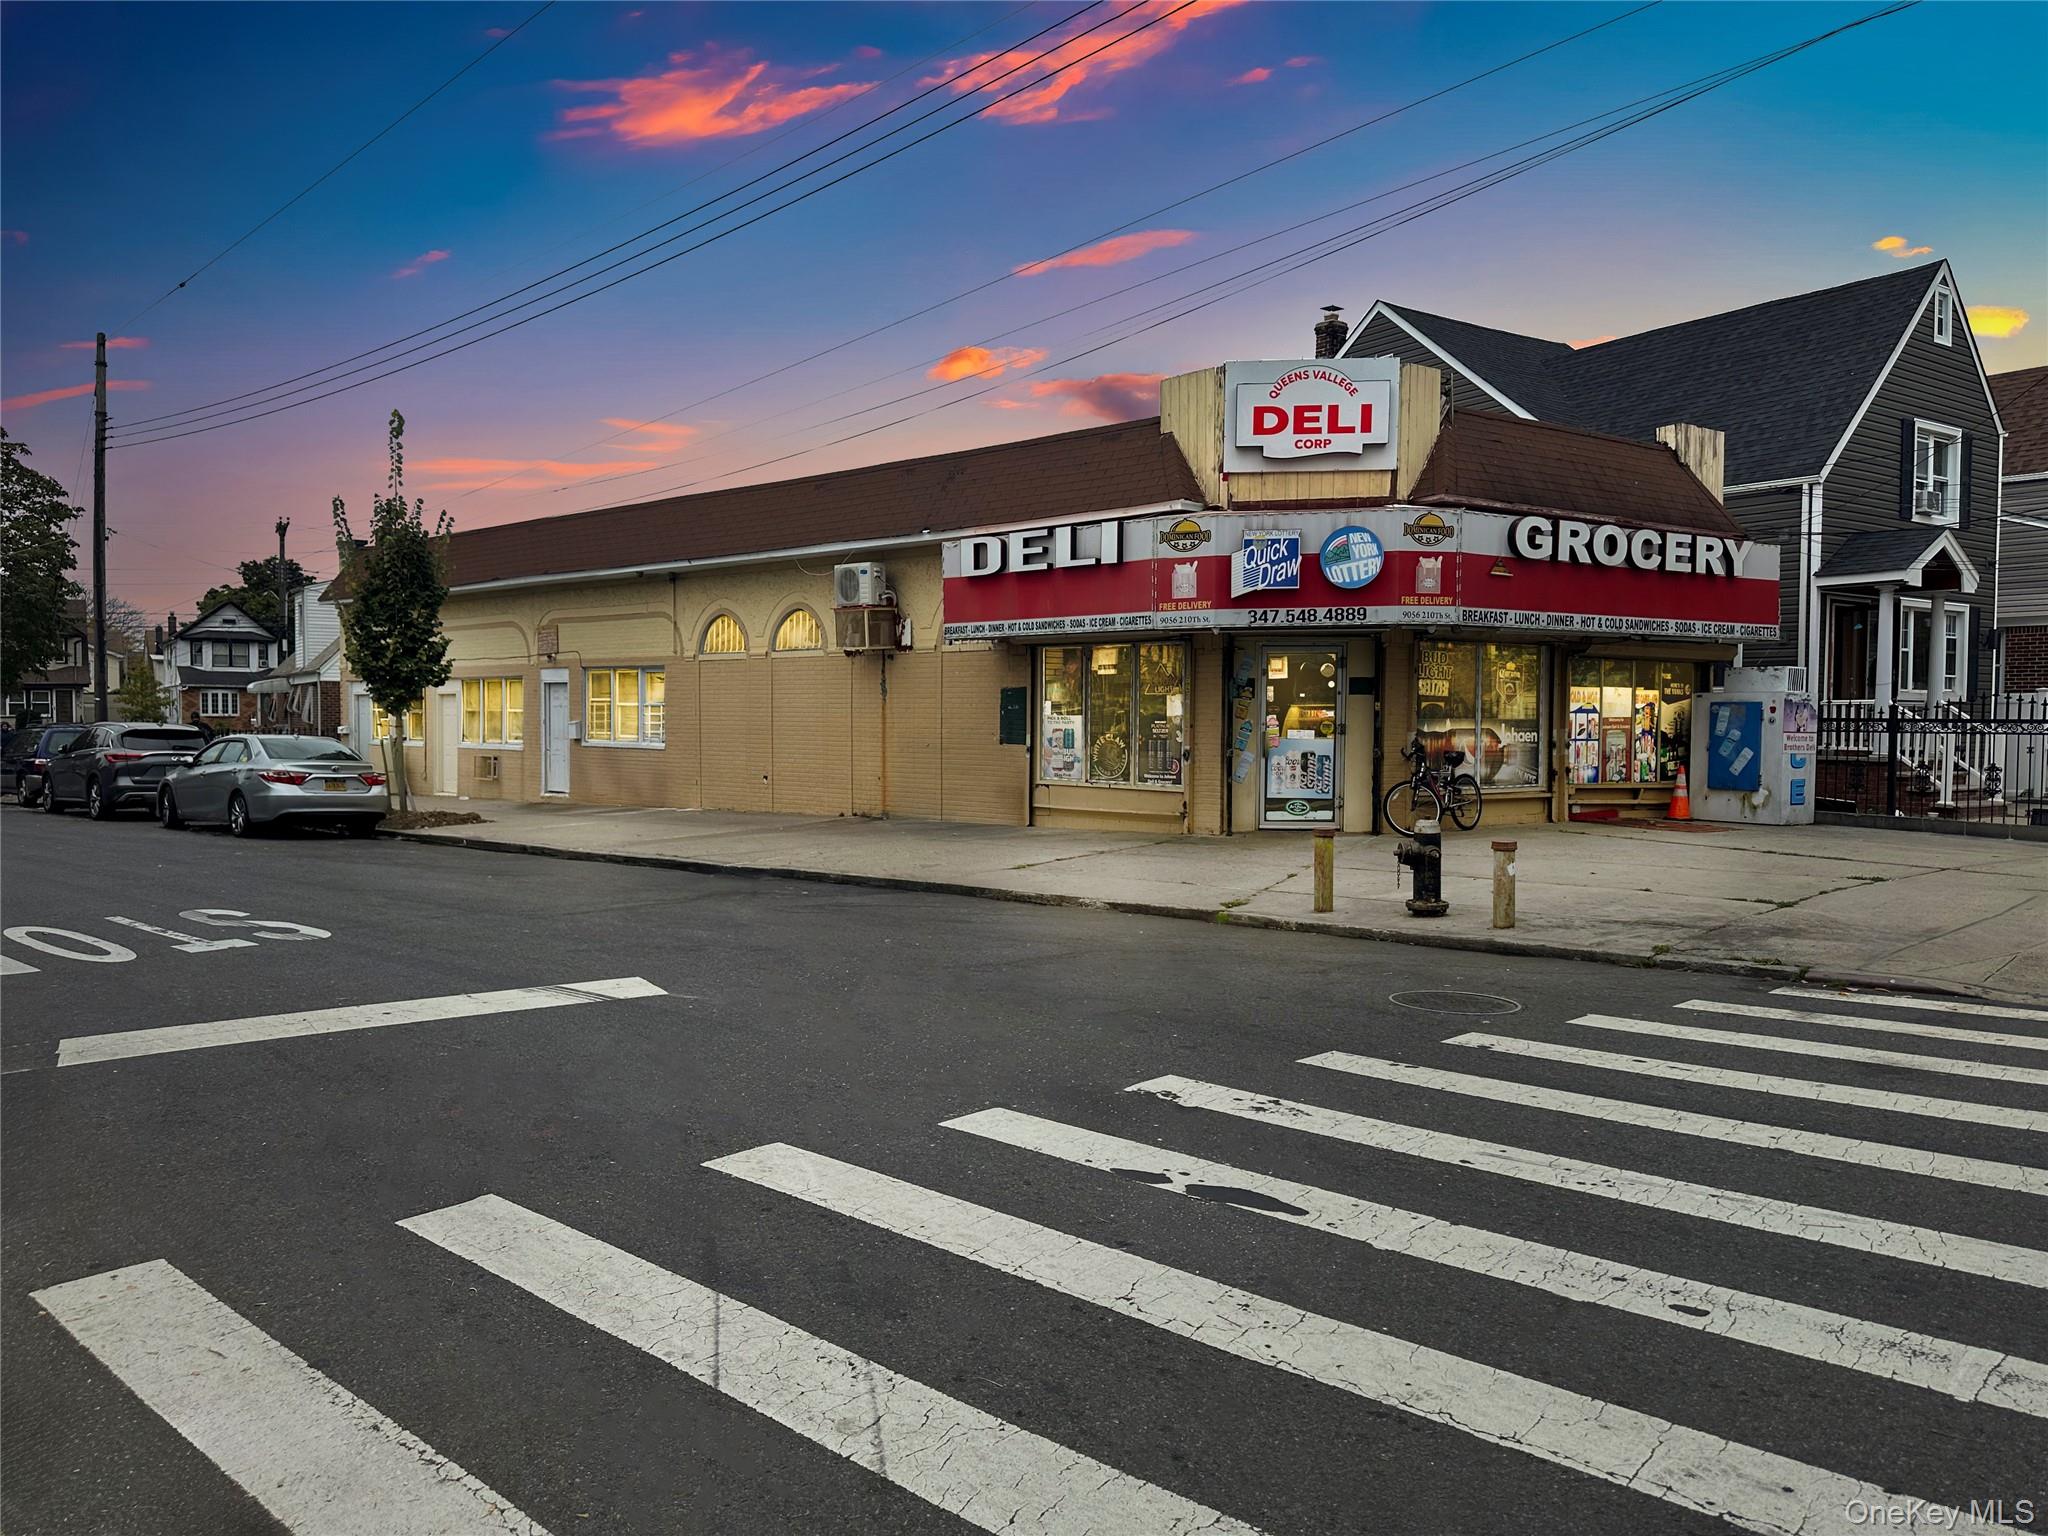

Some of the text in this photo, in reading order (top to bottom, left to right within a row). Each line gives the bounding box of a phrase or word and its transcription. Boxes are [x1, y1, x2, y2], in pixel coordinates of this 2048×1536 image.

[1269, 370, 1359, 399] QUEENS VALLEGE
[1253, 403, 1373, 436] DELI
[1294, 438, 1332, 449] CORP
[1159, 530, 1211, 545] DOMINICAN FOOD
[1350, 532, 1372, 544] NEW
[1403, 523, 1455, 538] DOMINICAN FOOD
[960, 520, 1121, 577] DELI
[1243, 538, 1288, 569] Quick
[1351, 543, 1378, 558] YORK
[1515, 515, 1754, 577] GROCERY
[1259, 556, 1302, 587] Draw
[1326, 556, 1382, 583] LOTTERY
[1159, 600, 1212, 611] FREE DELIVERY
[1401, 596, 1453, 605] FREE DELIVERY
[1159, 616, 1178, 625] 9056
[1248, 606, 1367, 624] 347.548.4889
[1402, 611, 1421, 619] 9056
[944, 625, 968, 635] BREAKFAST
[971, 623, 985, 634] LUNCH
[988, 622, 1005, 632] DINNER
[1007, 621, 1017, 631] HOT
[1022, 621, 1034, 631] COLD
[1035, 618, 1066, 631] SANDWICHES
[1069, 617, 1086, 628] SODAS
[1089, 617, 1098, 627] ICE
[1099, 616, 1116, 627] CREAM
[1119, 615, 1152, 625] CIGARETTES
[1462, 609, 1777, 638] BREAKFAST LUNCH DINNER HOT & COLD SANDWICHES SODAS ICE CREAM CIGARETTES
[1422, 650, 1448, 664] BUD
[1418, 663, 1453, 679] LIGHT
[1105, 734, 1126, 749] CLAW
[1786, 734, 1808, 742] Welcome
[1092, 735, 1106, 762] WHITE
